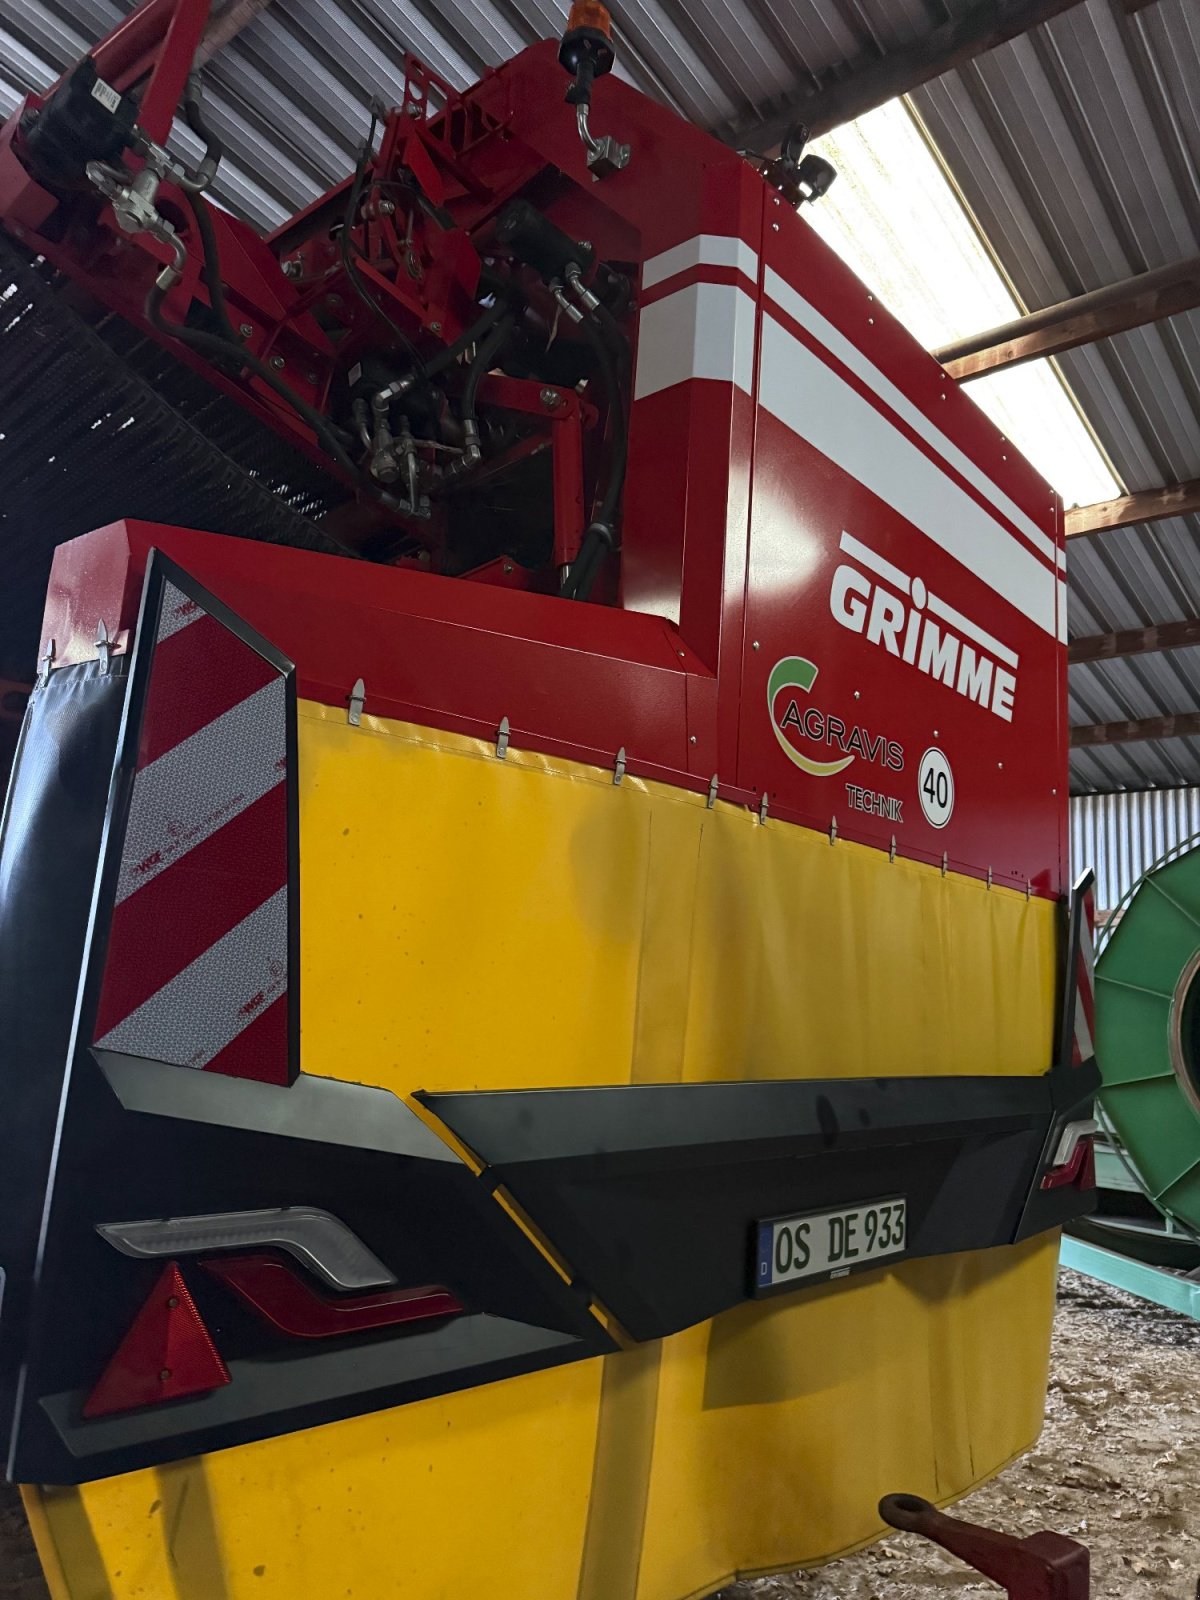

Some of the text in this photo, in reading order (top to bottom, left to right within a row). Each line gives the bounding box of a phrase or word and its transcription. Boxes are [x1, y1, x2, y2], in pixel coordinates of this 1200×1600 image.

[780, 699, 904, 771] AGRAVIS
[845, 783, 903, 823] TECHNIK
[923, 767, 948, 808] 40
[775, 1203, 905, 1274] OS DE 933
[760, 1261, 768, 1276] D
